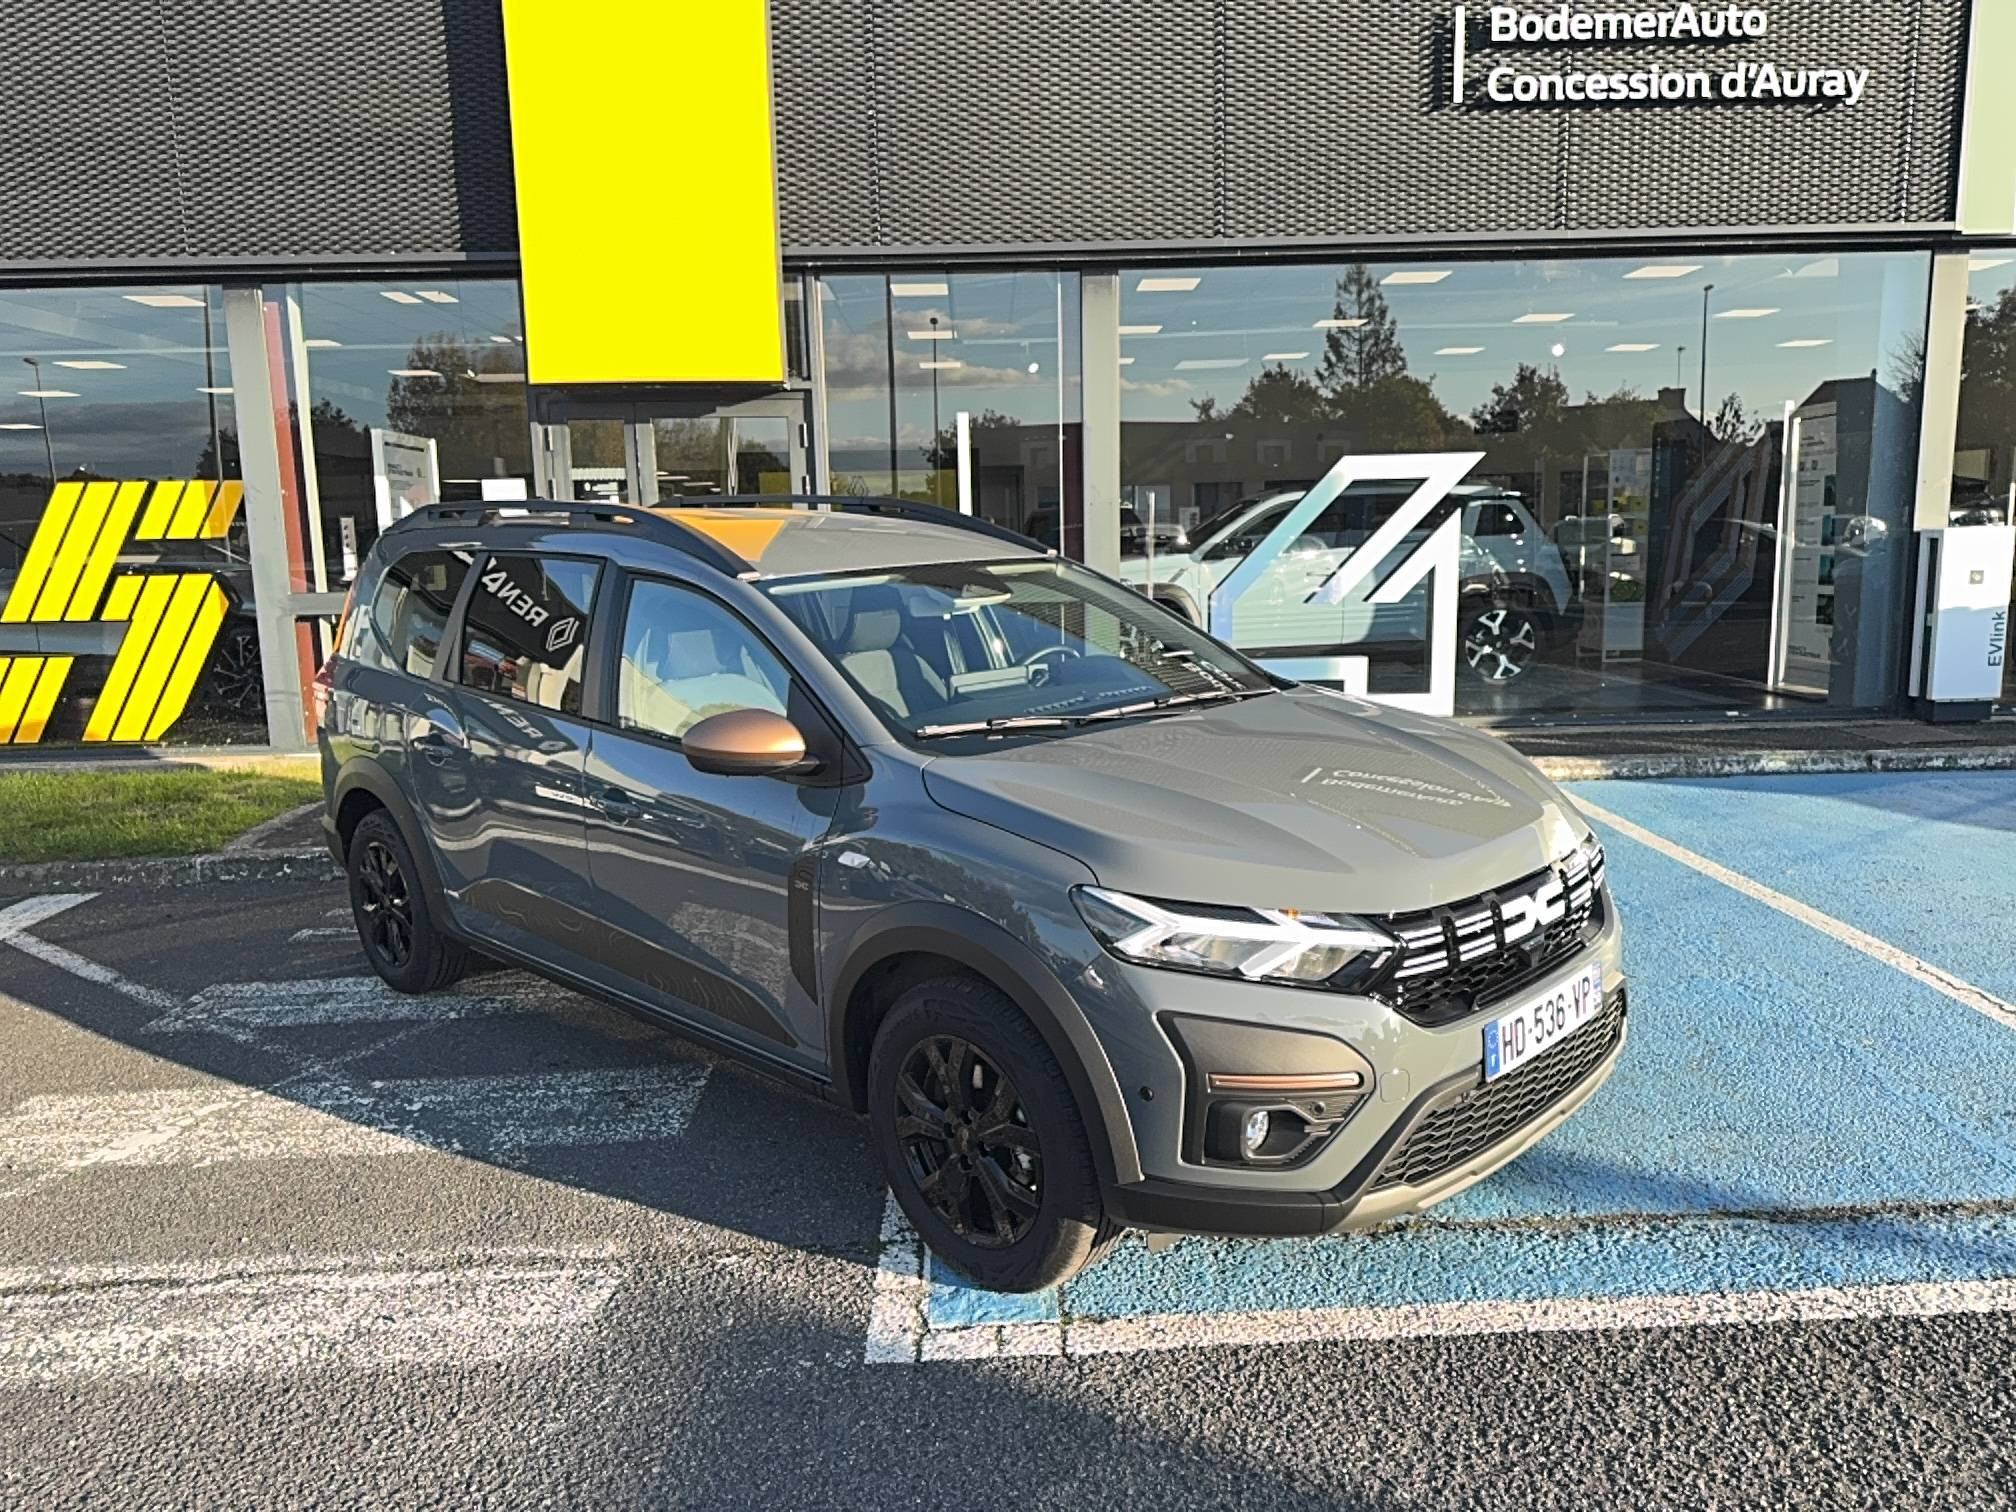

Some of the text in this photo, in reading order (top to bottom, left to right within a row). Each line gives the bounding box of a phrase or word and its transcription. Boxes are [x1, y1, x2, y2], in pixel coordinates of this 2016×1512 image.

[1489, 3, 1768, 43] BodemerAuto
[1486, 62, 1870, 105] Concession d'Auray
[1987, 610, 2006, 668] EVlink
[1501, 975, 1591, 1065] HD-536-VP
